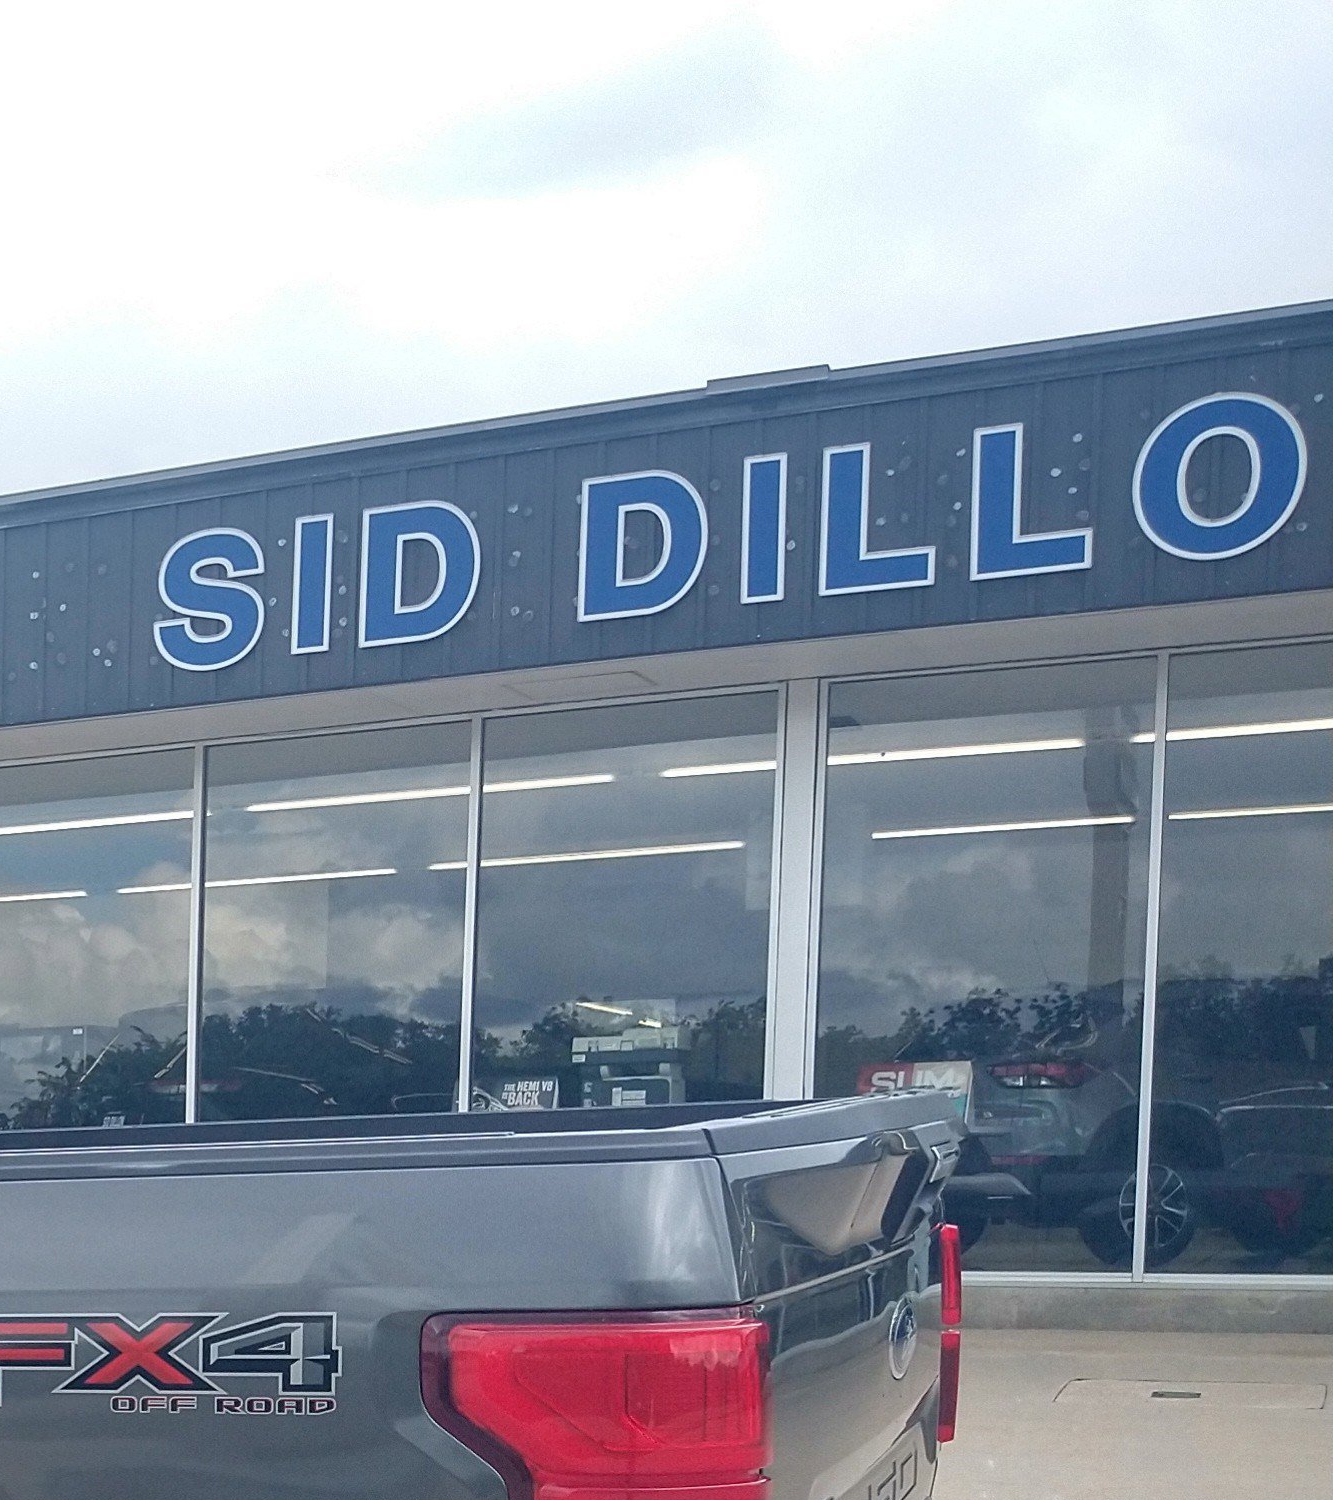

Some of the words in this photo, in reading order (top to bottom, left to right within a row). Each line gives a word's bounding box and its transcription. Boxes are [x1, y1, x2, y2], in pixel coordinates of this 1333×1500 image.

[153, 500, 482, 672] SID
[576, 391, 1309, 624] DILLO
[517, 1081, 540, 1092] HEMI
[507, 1091, 539, 1106] BACK
[110, 1396, 197, 1413] OFF
[214, 1396, 337, 1415] ROAD
